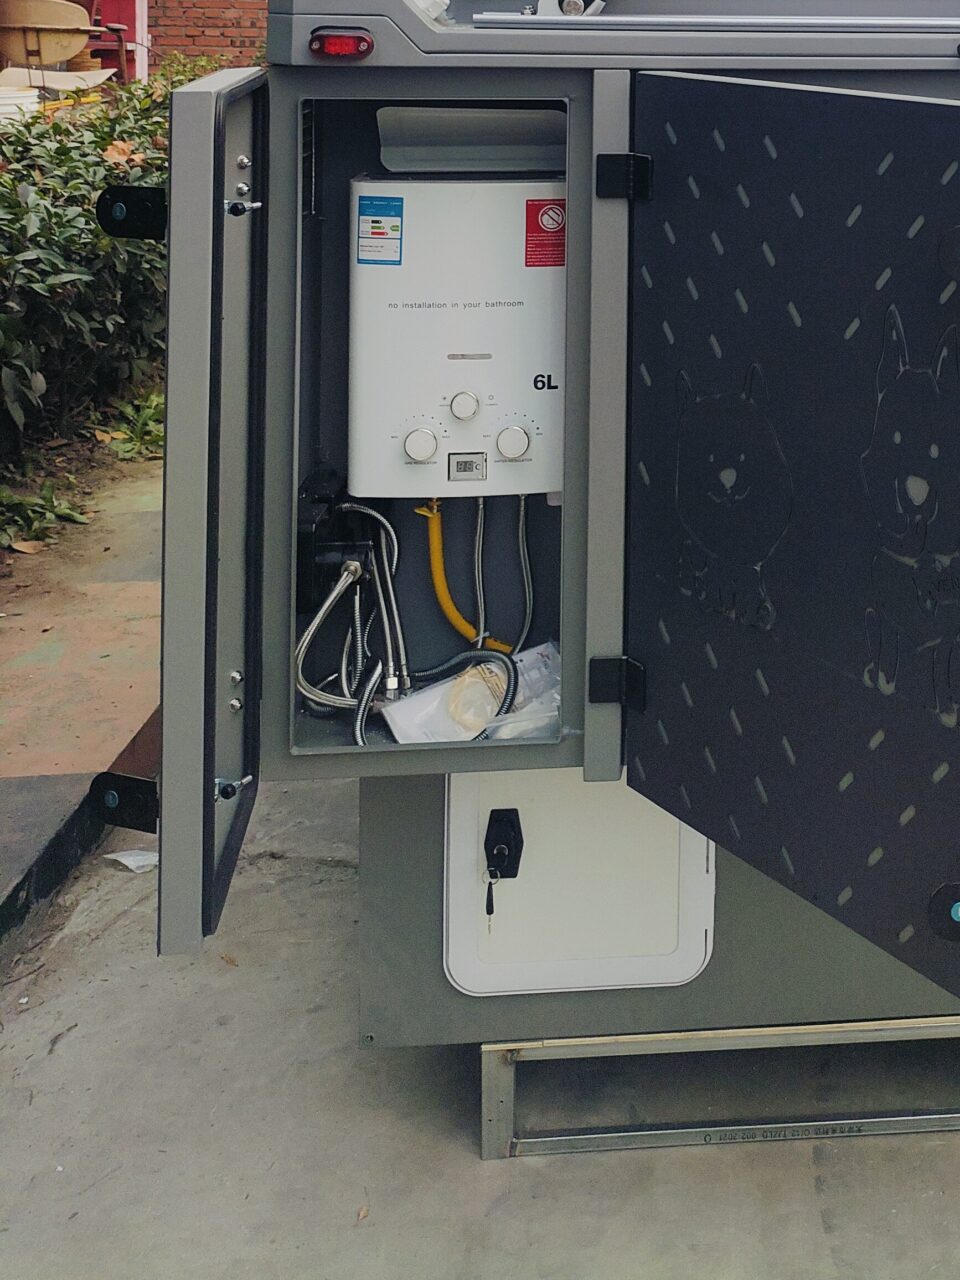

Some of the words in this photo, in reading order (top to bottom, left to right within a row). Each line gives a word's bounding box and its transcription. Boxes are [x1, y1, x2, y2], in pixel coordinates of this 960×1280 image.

[402, 301, 448, 309] installation
[451, 301, 459, 309] in
[463, 301, 481, 310] your
[485, 300, 525, 308] bathroom
[533, 374, 559, 391] 6L
